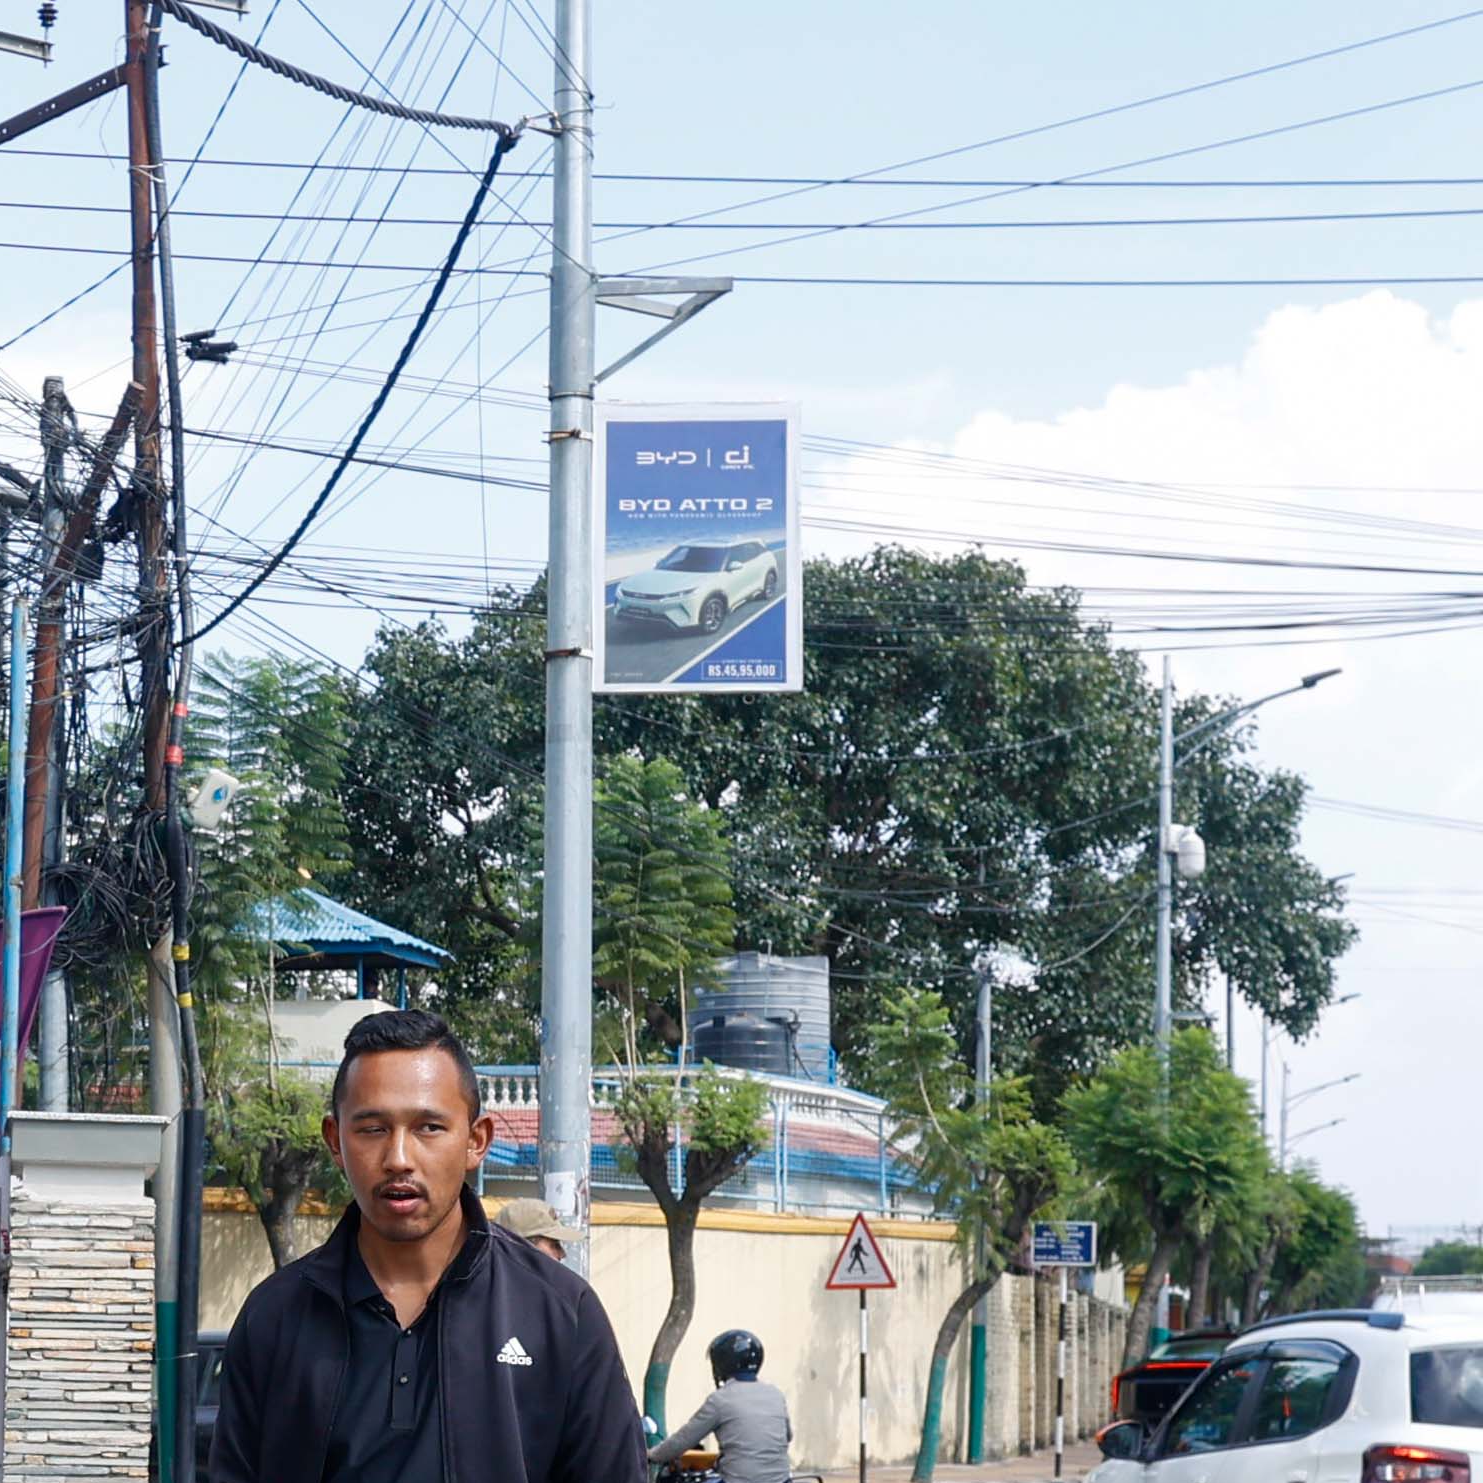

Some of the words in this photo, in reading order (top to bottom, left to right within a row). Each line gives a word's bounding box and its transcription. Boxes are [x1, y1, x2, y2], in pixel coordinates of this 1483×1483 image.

[635, 451, 697, 465] BYD
[618, 498, 671, 512] BYD
[679, 498, 748, 512] ATTO
[755, 498, 774, 512] 2
